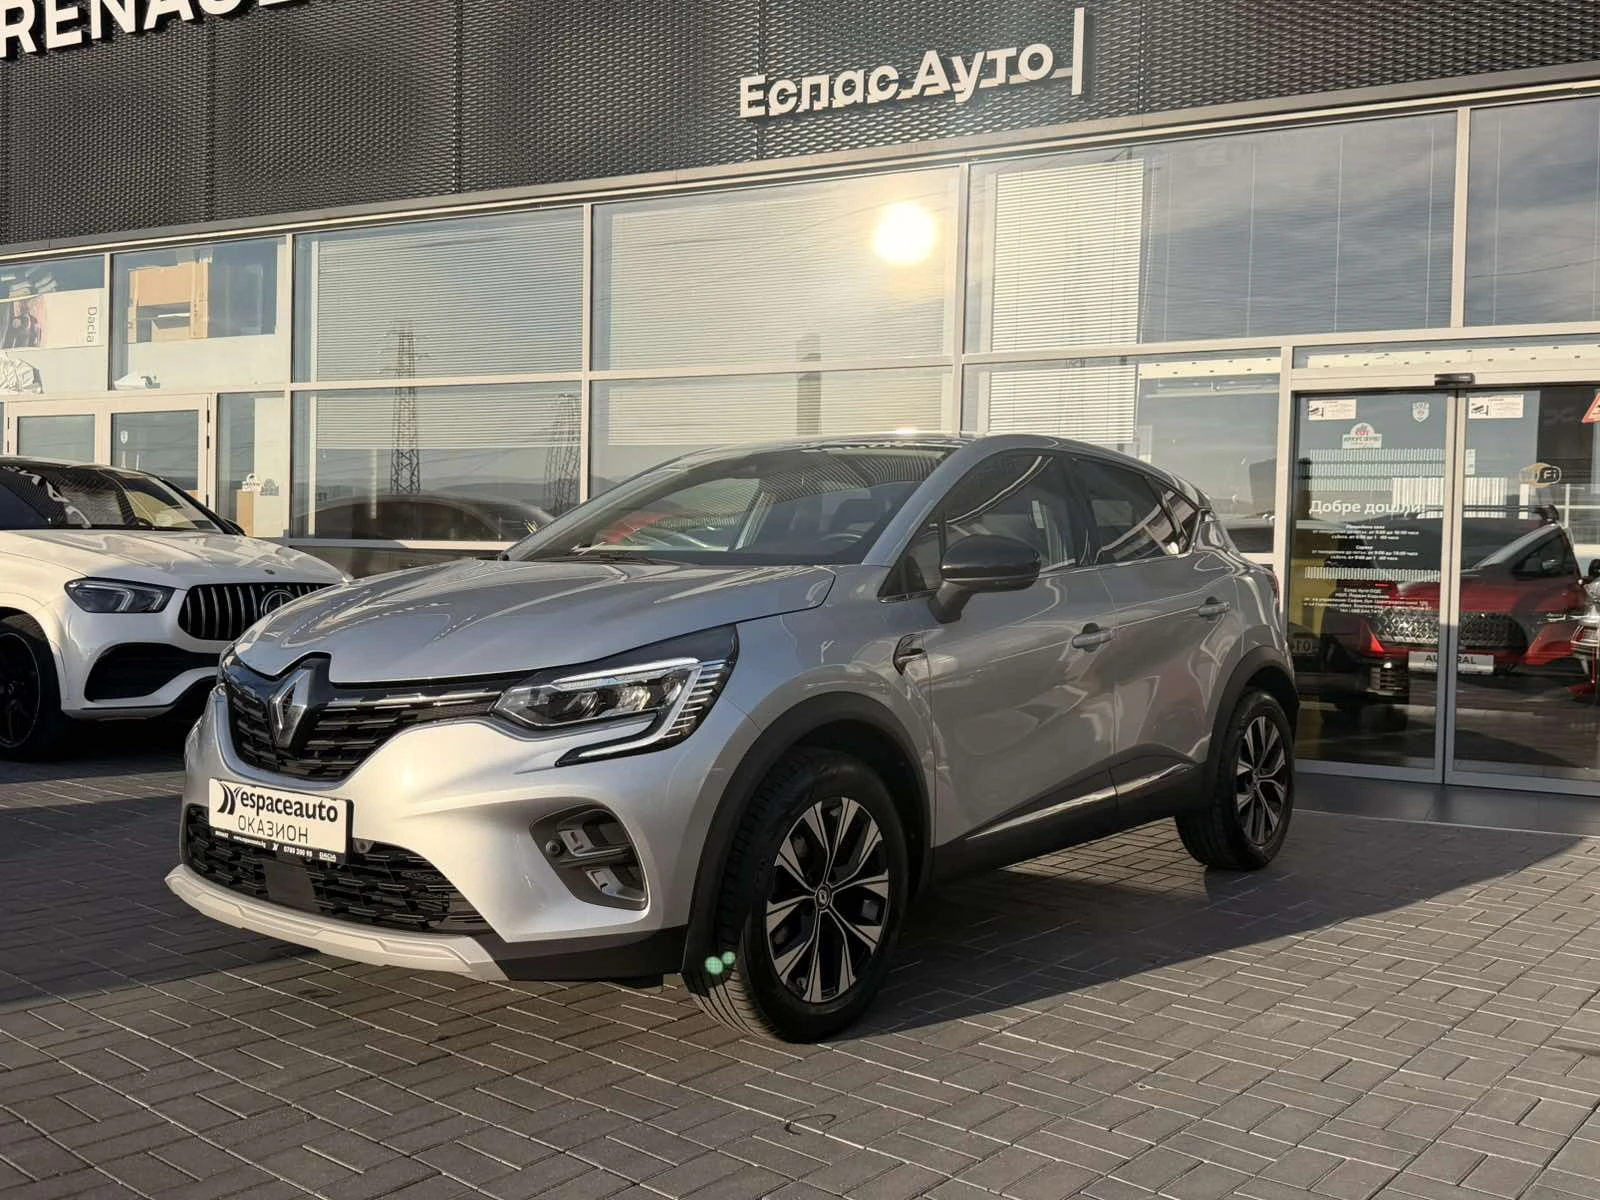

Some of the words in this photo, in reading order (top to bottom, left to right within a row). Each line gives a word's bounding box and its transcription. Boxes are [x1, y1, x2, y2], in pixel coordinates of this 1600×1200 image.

[0, 0, 290, 58] REN
[739, 65, 899, 118] Еспас
[911, 43, 1054, 104] Ауто
[87, 306, 98, 343] Dacia
[1309, 500, 1361, 516] Добре
[1425, 654, 1477, 665] AURAL
[240, 790, 338, 822] espaceauto
[238, 814, 308, 844] ОКАЗИОН
